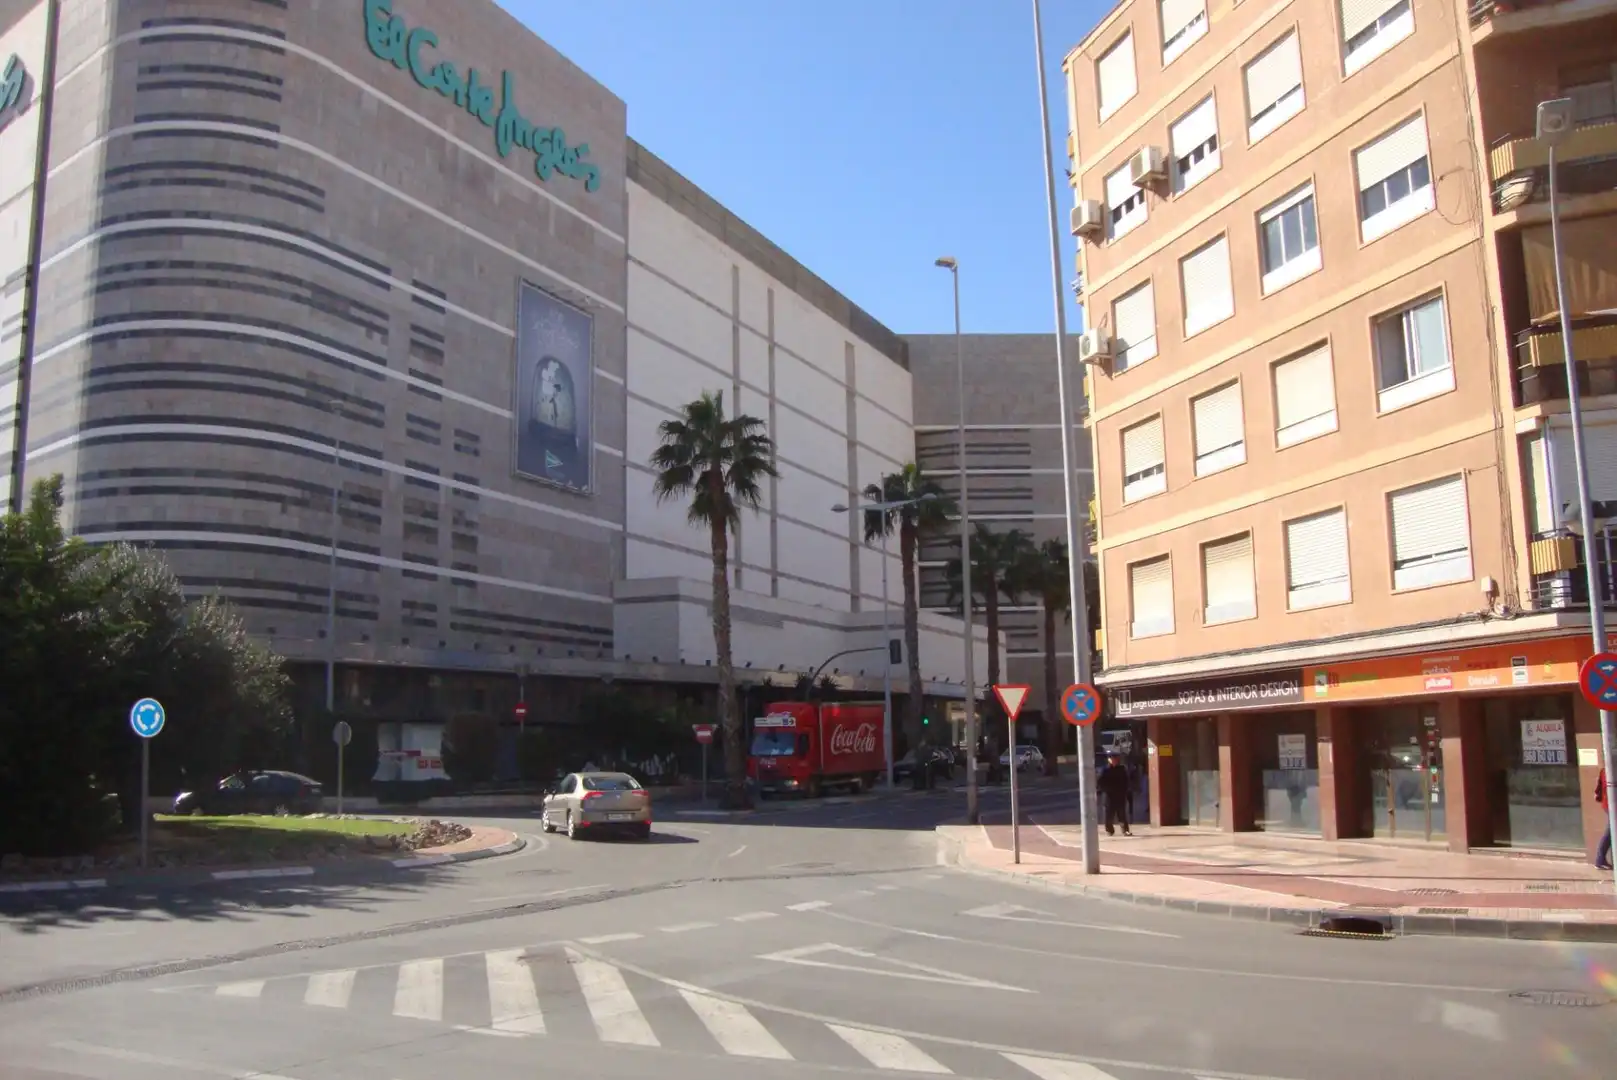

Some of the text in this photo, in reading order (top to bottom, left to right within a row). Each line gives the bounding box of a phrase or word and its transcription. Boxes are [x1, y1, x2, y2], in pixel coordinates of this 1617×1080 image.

[364, 0, 408, 69] El
[407, 27, 495, 127] Corte
[1207, 690, 1215, 703] &
[1216, 684, 1258, 703] INTERIOR
[1260, 680, 1299, 698] DESIGN
